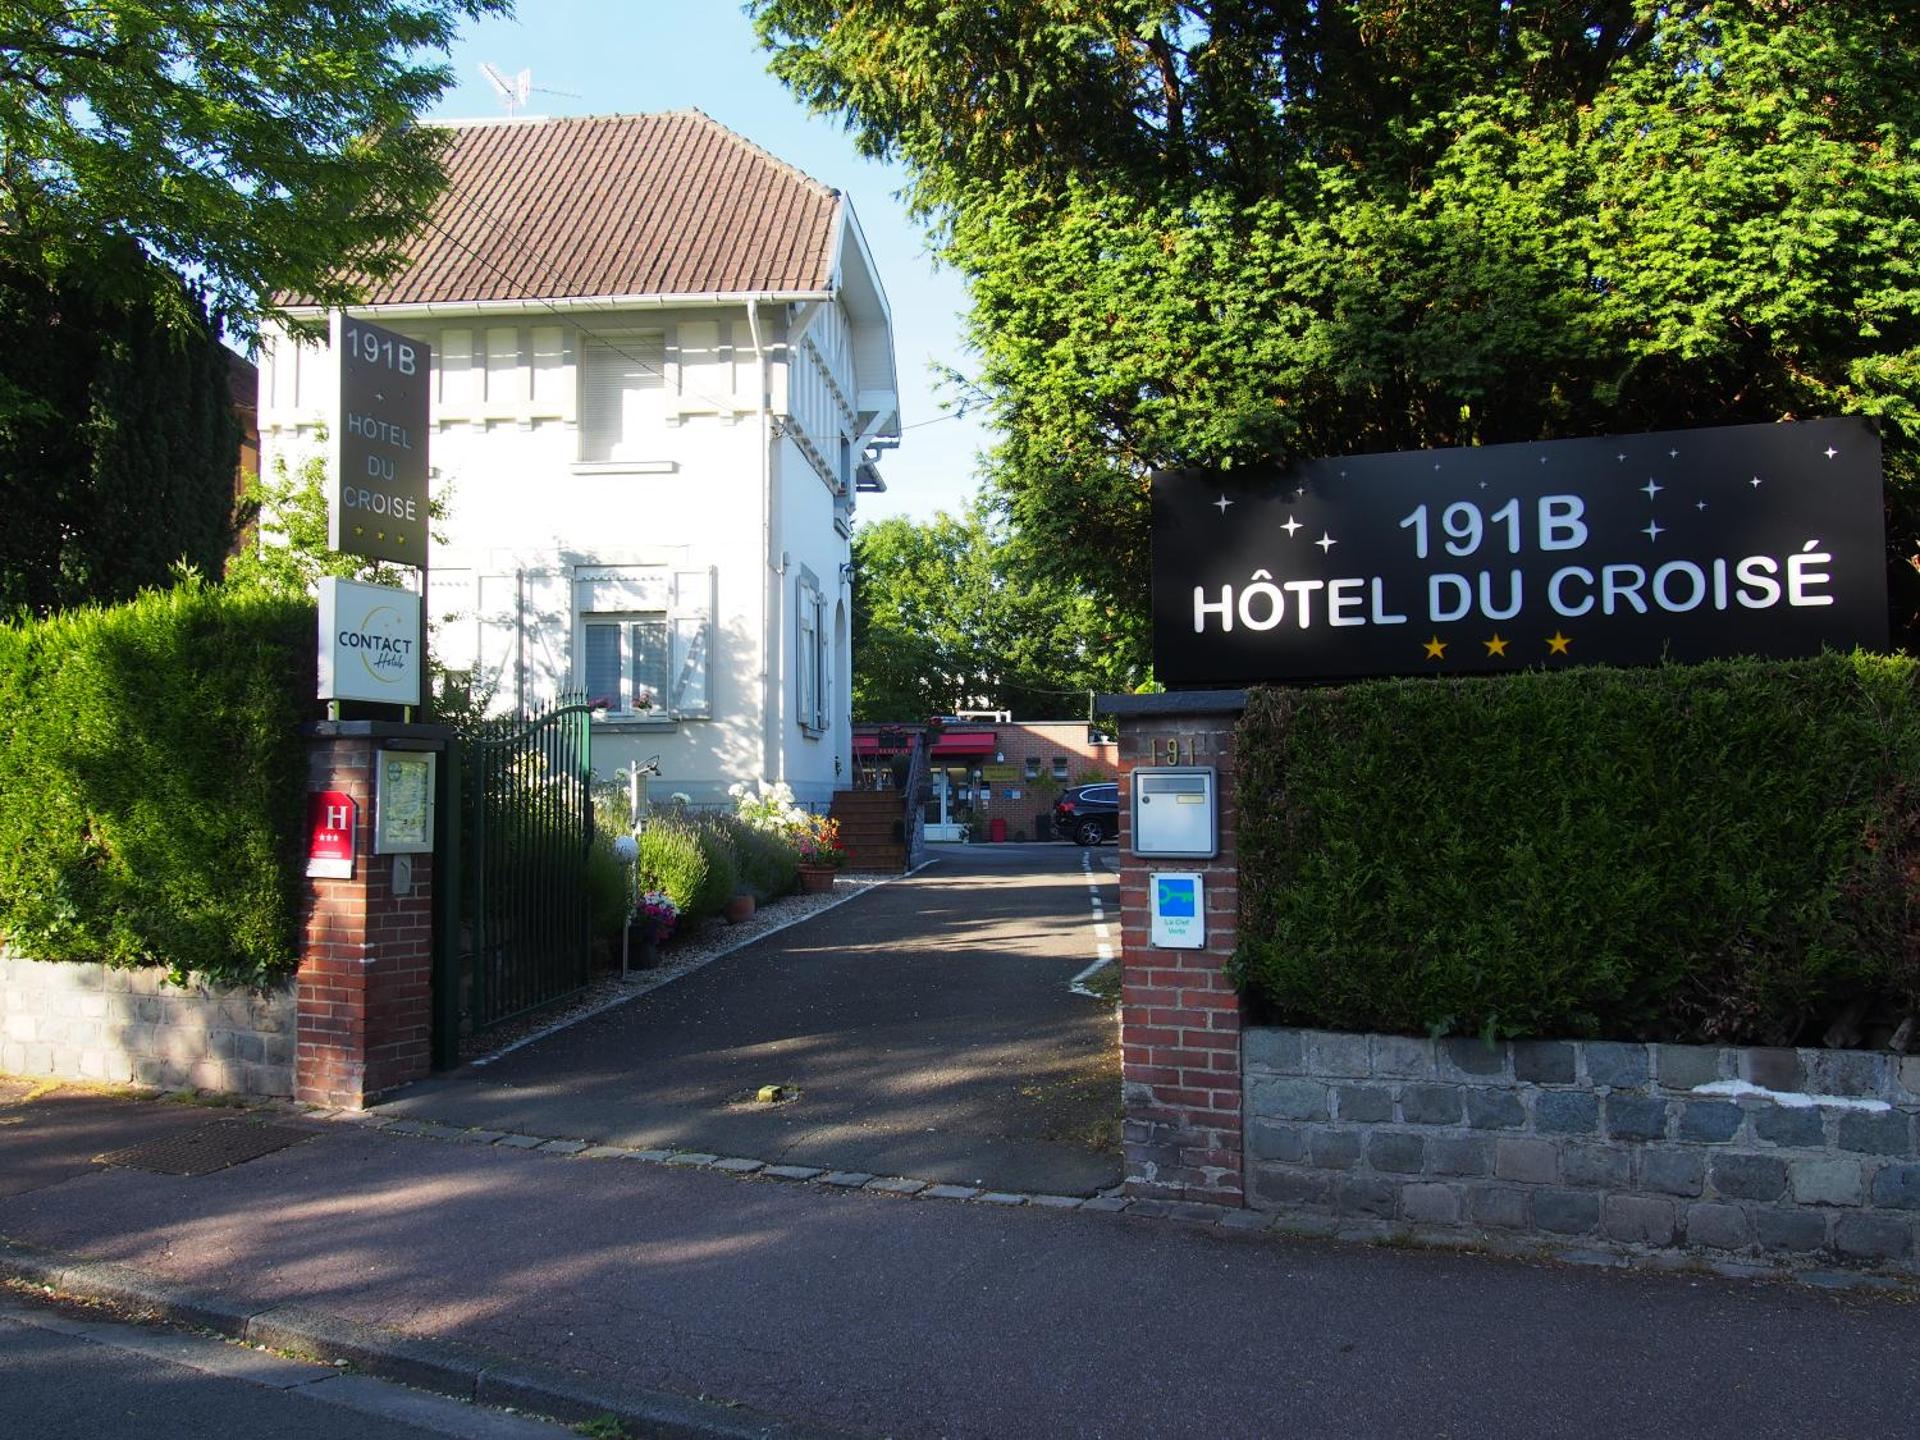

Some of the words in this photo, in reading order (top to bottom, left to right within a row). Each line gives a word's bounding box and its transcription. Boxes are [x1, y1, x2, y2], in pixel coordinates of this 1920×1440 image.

[348, 328, 416, 376] 191B
[368, 456, 395, 481] DU
[344, 486, 416, 521] CROISÉ
[1400, 495, 1588, 559] 191B
[1194, 569, 1407, 633] HÔTEL
[1429, 570, 1523, 622] DU
[1549, 540, 1834, 617] CROISÉ
[339, 632, 412, 654] CONTACT
[1151, 738, 1195, 766] 191
[326, 807, 348, 829] H
